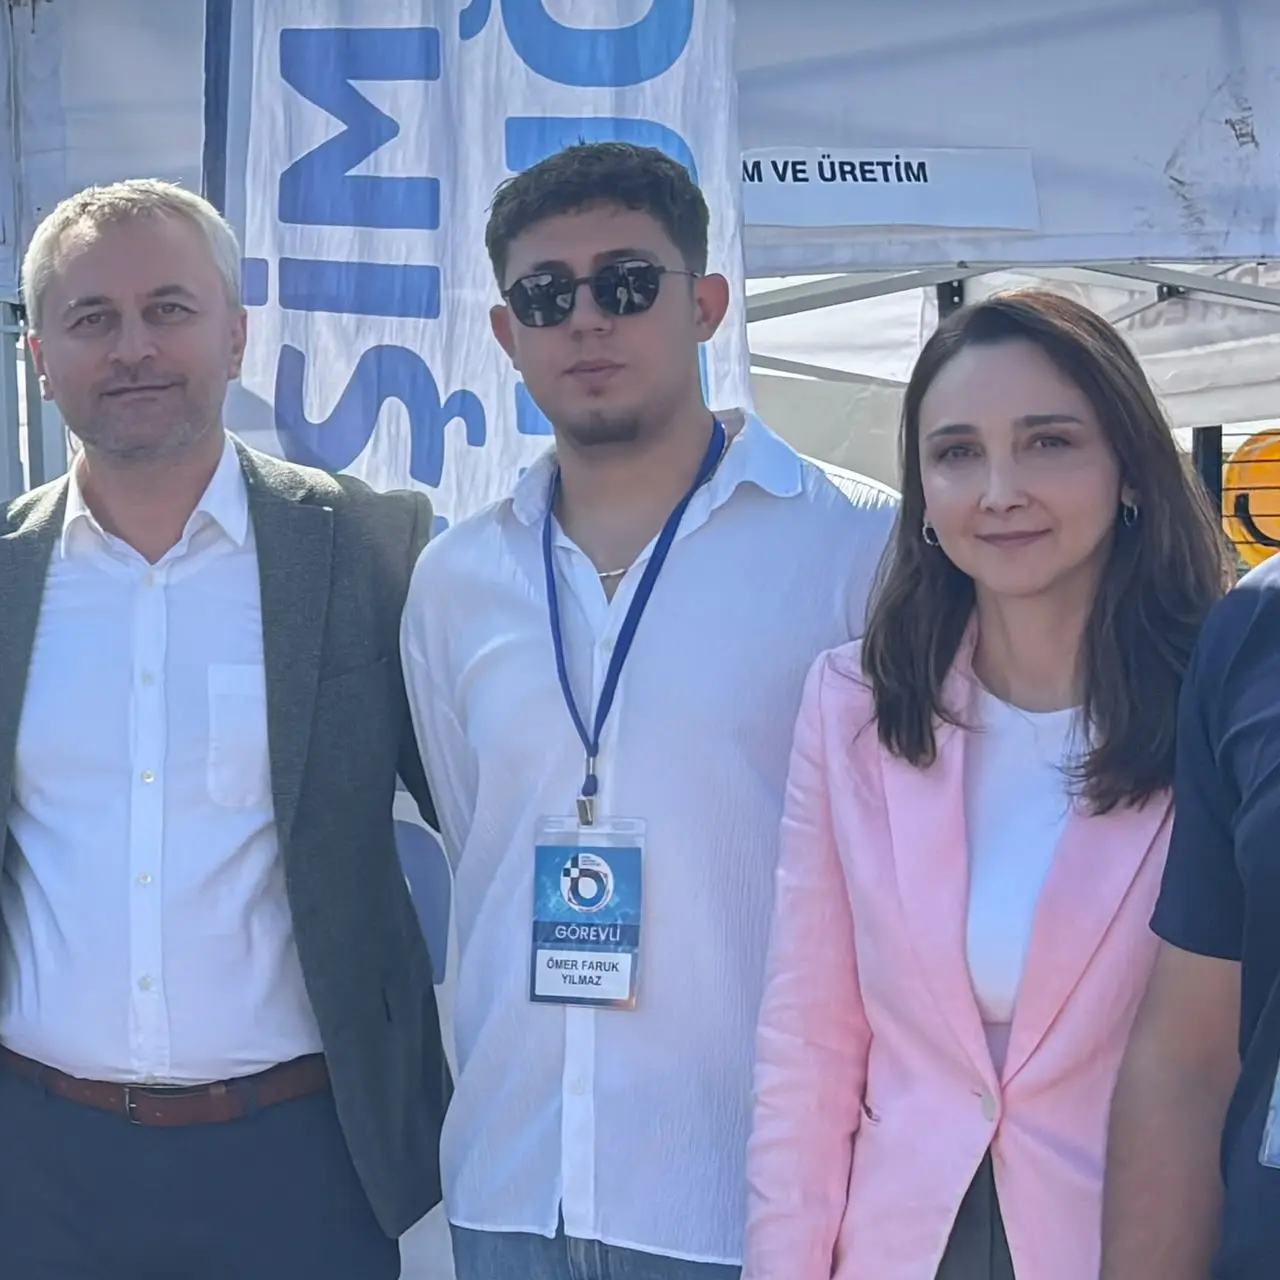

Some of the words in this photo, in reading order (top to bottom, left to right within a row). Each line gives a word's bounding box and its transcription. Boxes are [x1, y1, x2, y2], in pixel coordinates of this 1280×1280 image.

[771, 160, 810, 183] VE
[818, 154, 929, 183] ÜRETİM
[555, 924, 620, 941] GÖREVLİ
[547, 957, 578, 970] ÖMER
[581, 959, 619, 972] FARUK
[561, 973, 602, 986] YILMAZ
